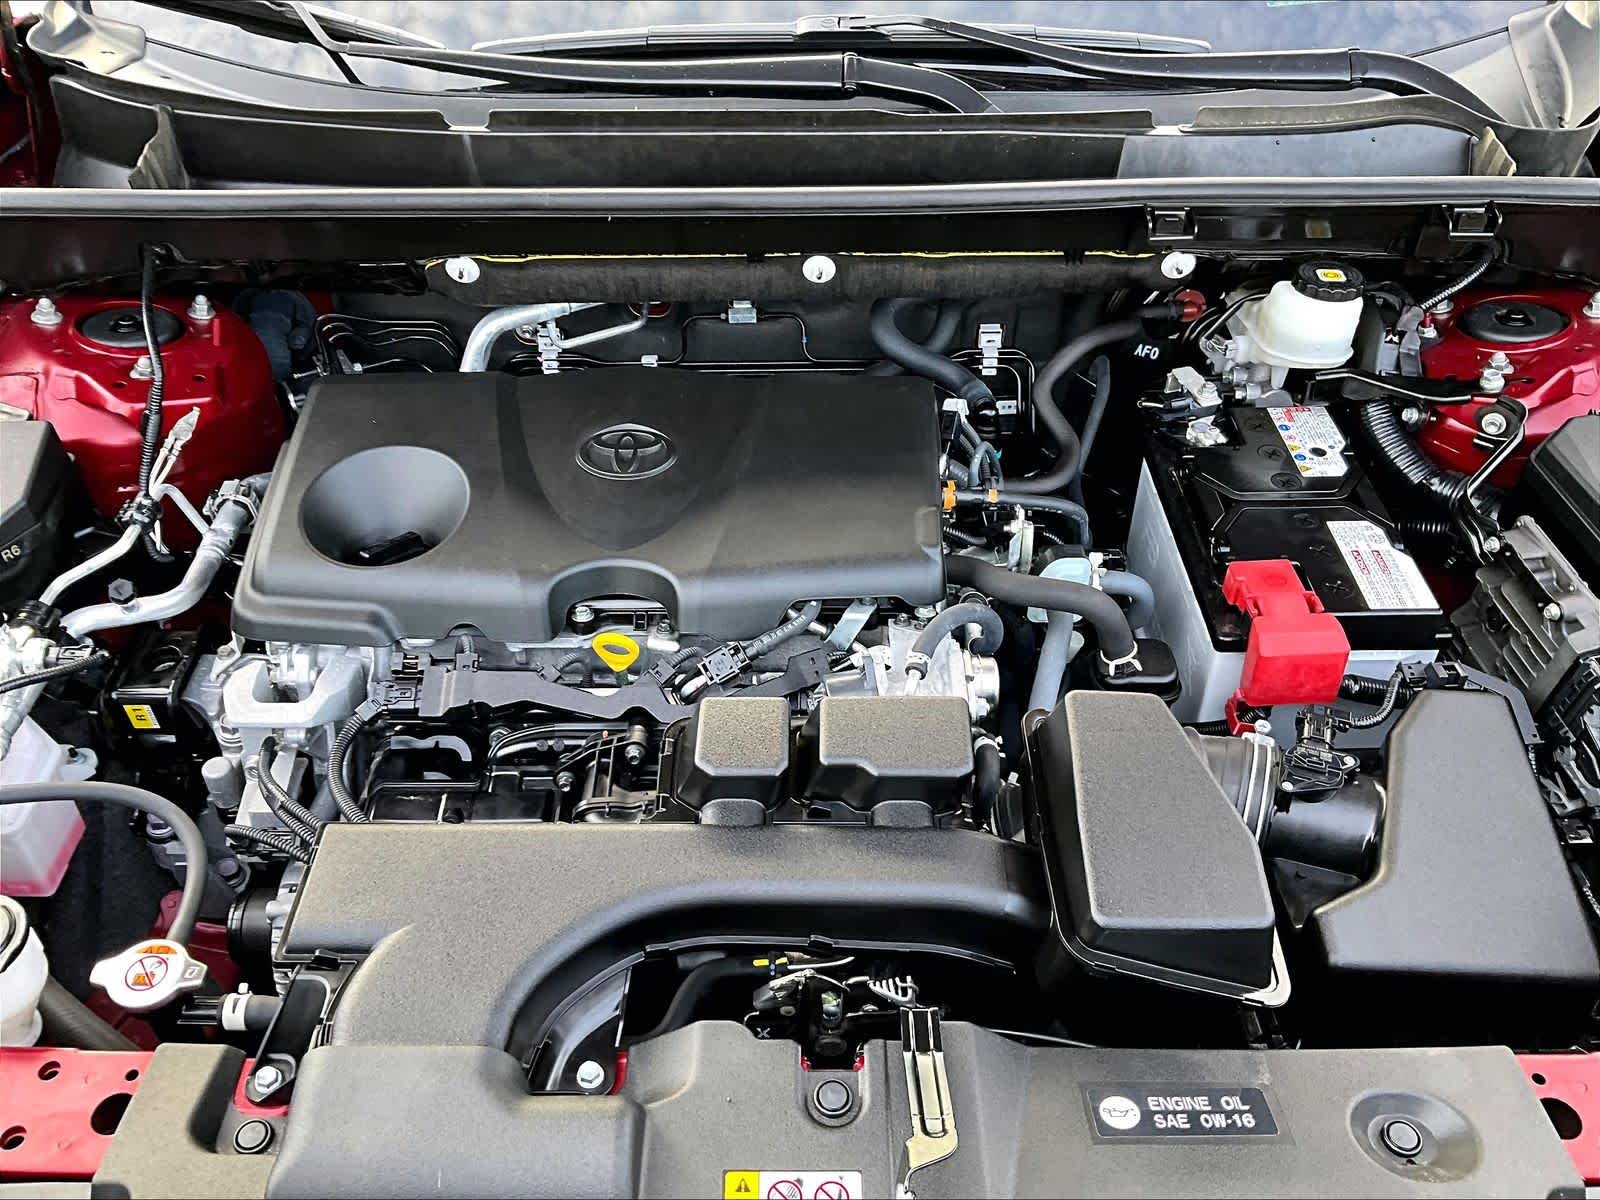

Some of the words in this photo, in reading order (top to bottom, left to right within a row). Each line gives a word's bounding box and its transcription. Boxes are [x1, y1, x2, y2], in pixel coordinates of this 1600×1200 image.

[1, 544, 21, 562] R6
[1146, 1095, 1212, 1111] ENGINE
[1220, 1095, 1250, 1111] OIL
[1153, 1113, 1191, 1129] SAE
